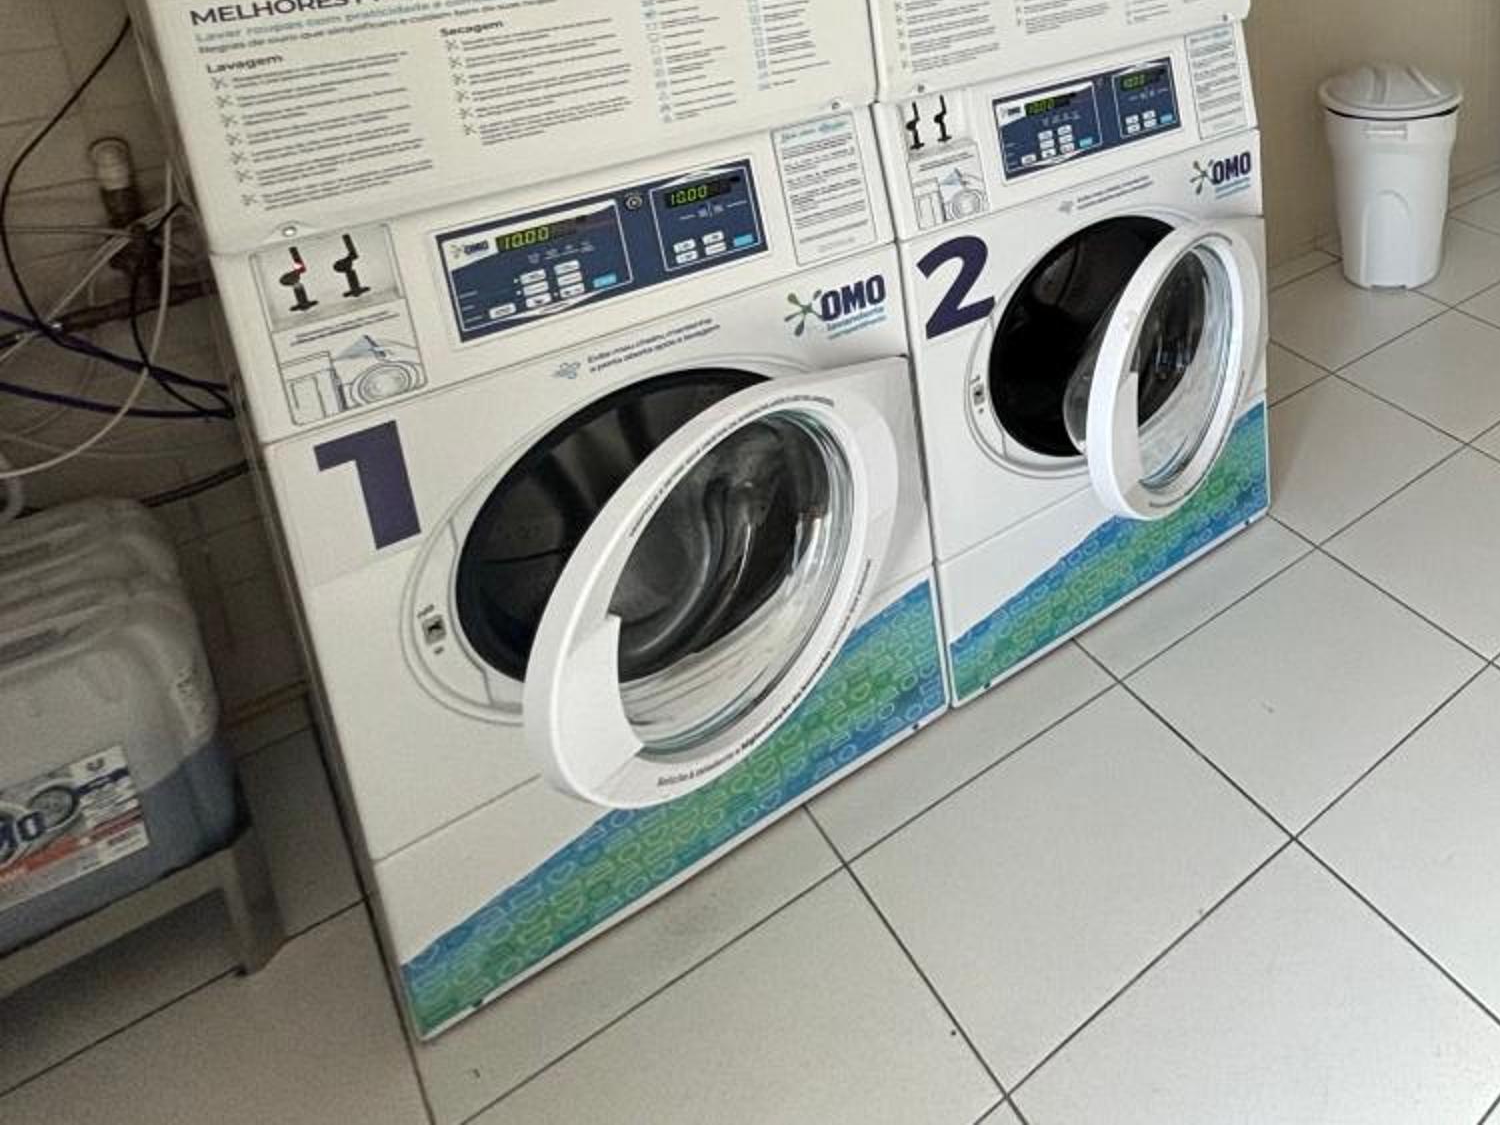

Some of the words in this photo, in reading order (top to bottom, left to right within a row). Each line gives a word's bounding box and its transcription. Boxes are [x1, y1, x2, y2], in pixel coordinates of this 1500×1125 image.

[207, 54, 283, 74] Lavagem
[439, 20, 504, 37] Secagem
[1212, 150, 1251, 186] OMO
[820, 274, 887, 322] OMO
[917, 235, 996, 339] 2
[313, 420, 422, 550] 1
